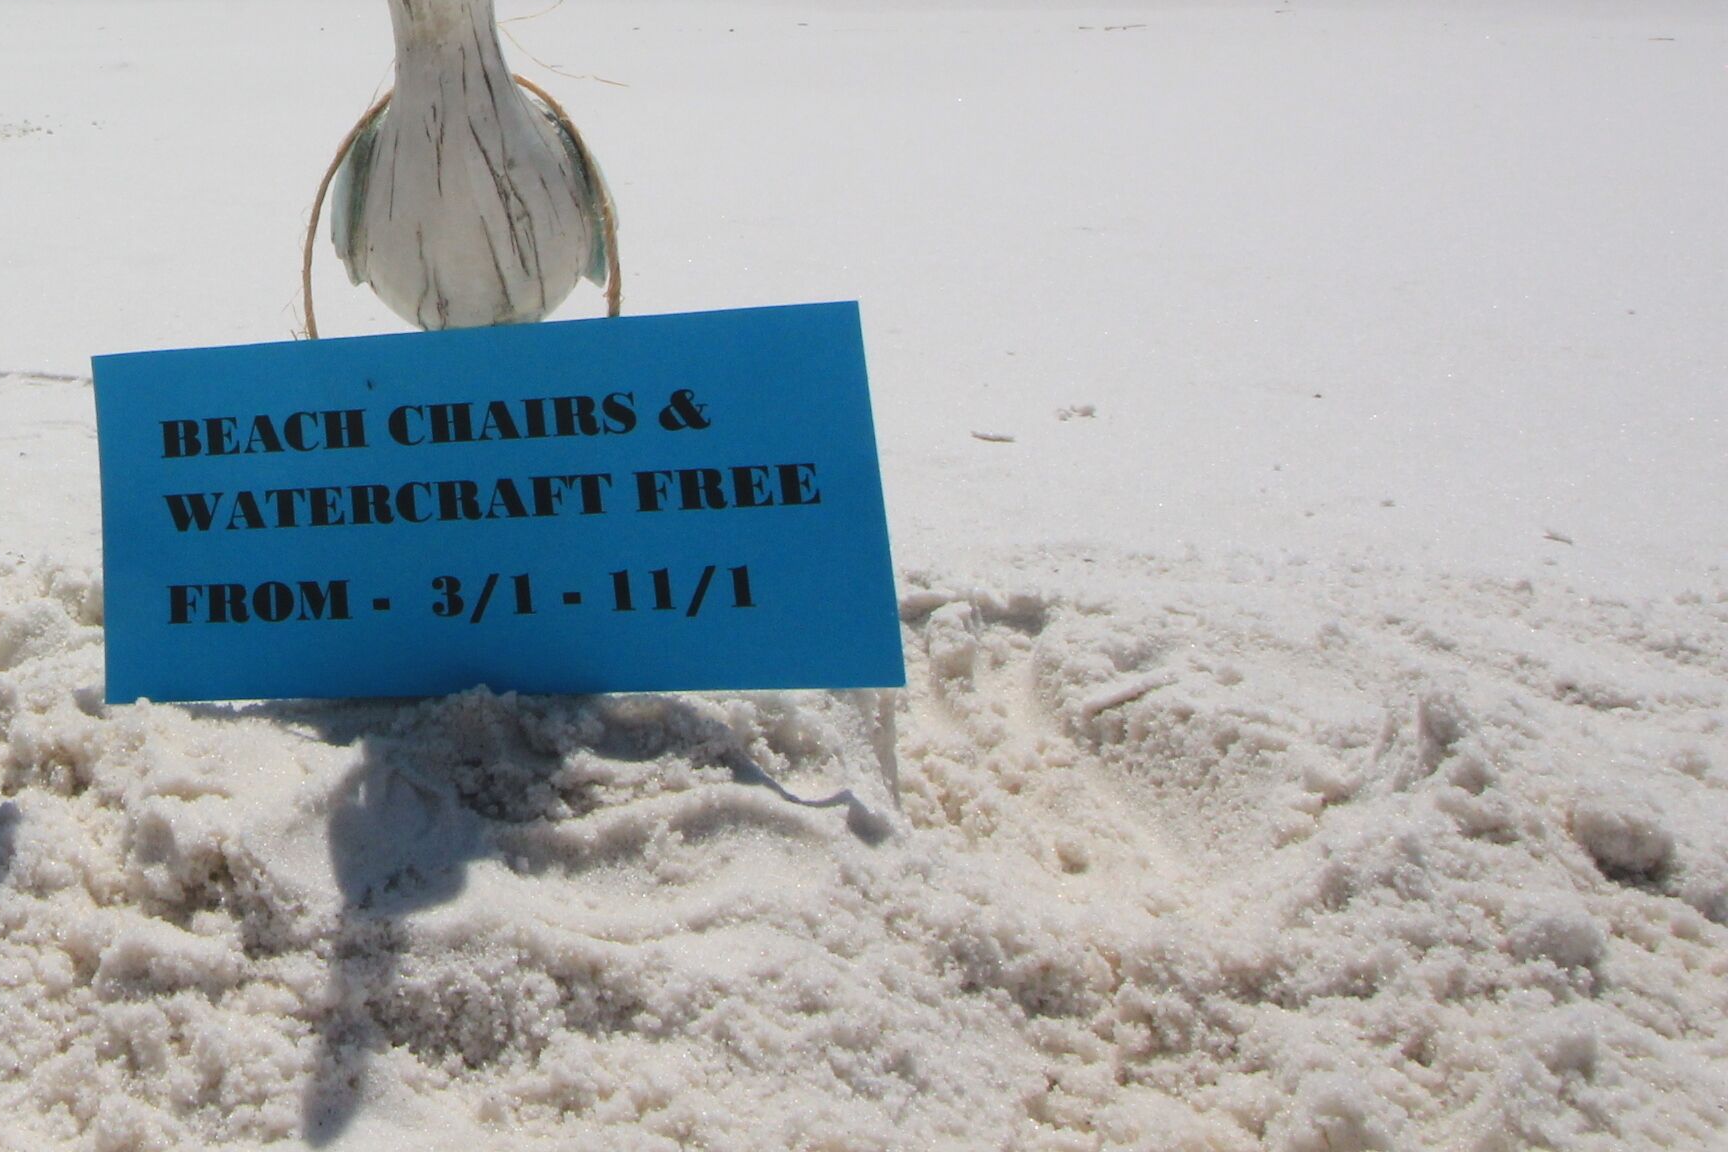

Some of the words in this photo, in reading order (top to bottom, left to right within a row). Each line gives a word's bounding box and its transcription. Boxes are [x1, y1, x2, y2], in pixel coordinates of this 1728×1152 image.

[160, 409, 368, 459] BEACH
[387, 392, 637, 447] CHAIRS
[658, 389, 711, 431] &
[163, 473, 612, 533] WATERCRAFT
[634, 463, 822, 513] FREE
[169, 580, 353, 625] FROM
[372, 598, 391, 612] -
[431, 573, 536, 625] 3/1
[562, 591, 582, 605] -
[610, 565, 756, 618] 11/1
